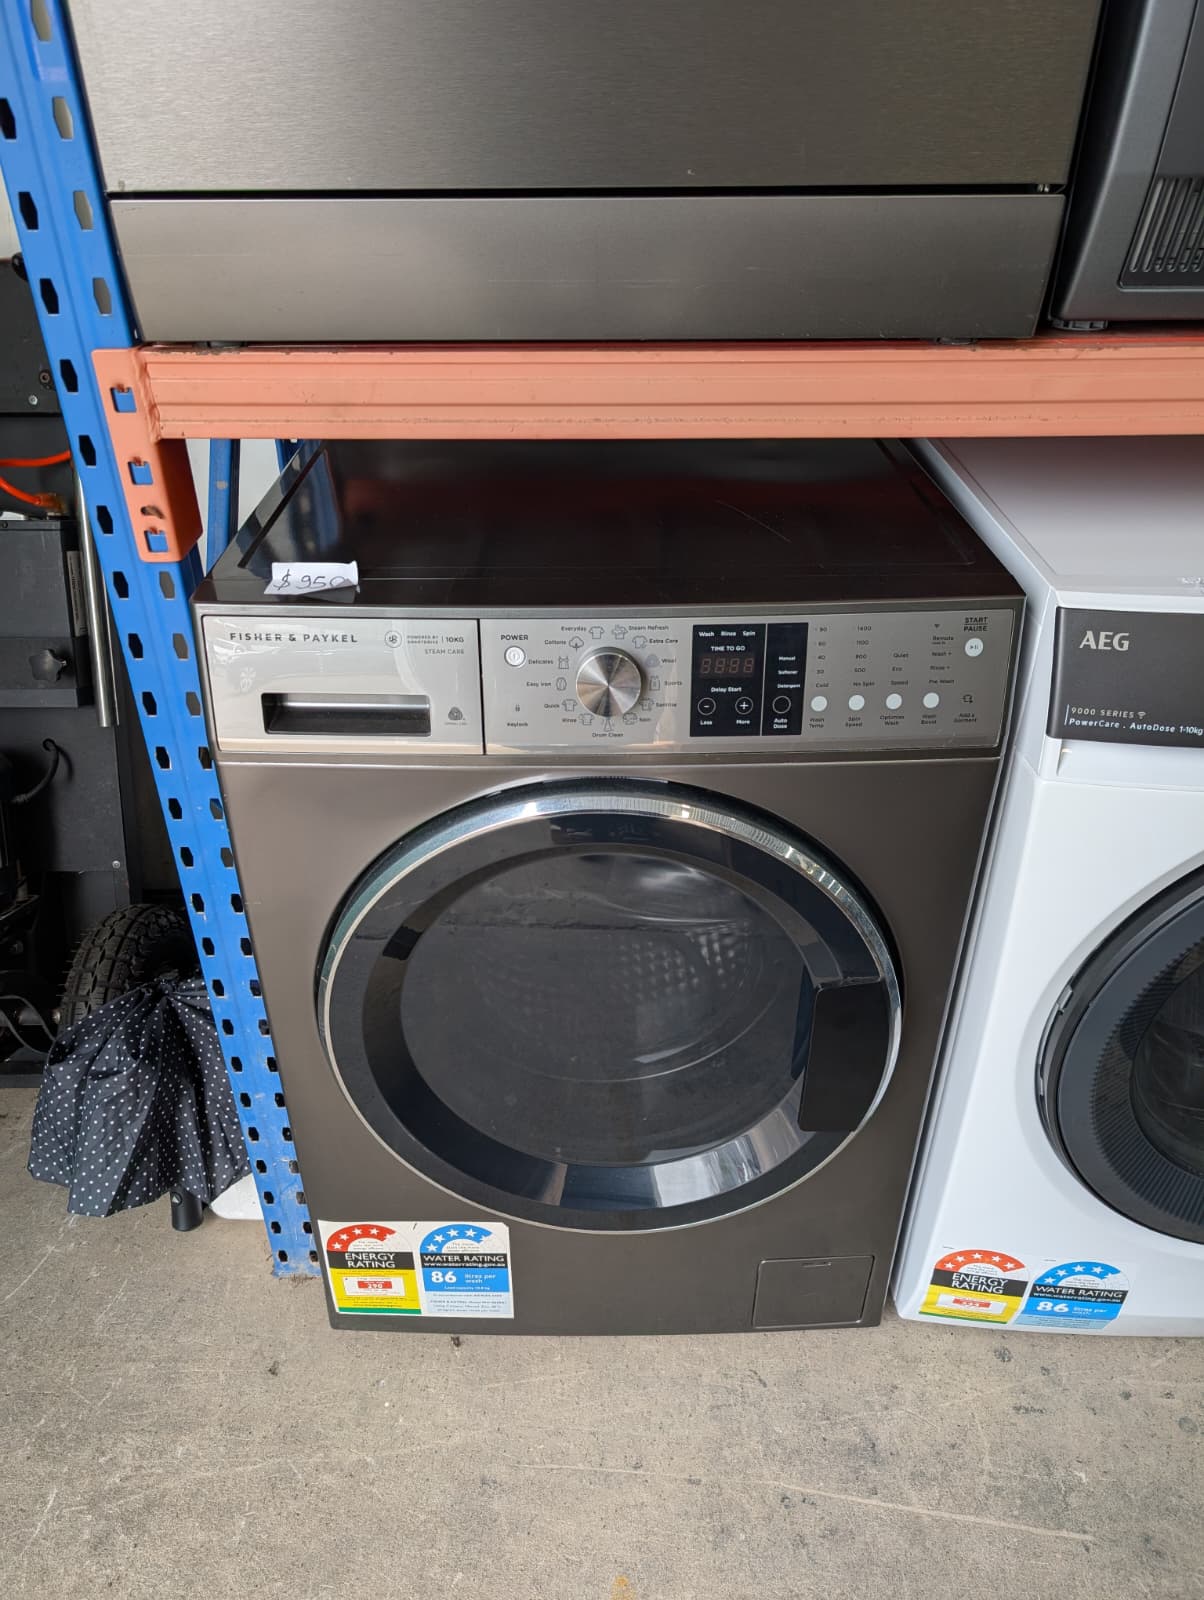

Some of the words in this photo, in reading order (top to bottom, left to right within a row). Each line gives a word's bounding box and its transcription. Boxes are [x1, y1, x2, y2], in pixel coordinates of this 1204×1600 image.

[273, 569, 291, 590] $
[296, 575, 345, 589] 950
[560, 625, 587, 633] Everyday
[230, 632, 283, 642] FISHER
[288, 633, 297, 642] &
[303, 633, 358, 643] PAYKEL
[1079, 630, 1130, 651] AEG
[1071, 707, 1096, 716] 9000
[1100, 709, 1135, 718] SERIES
[1069, 718, 1120, 729] PowerCare
[1129, 722, 1176, 733] AutoDose
[345, 1252, 396, 1261] ENERGY
[347, 1260, 396, 1269] RATING
[431, 1271, 457, 1283] 86
[952, 1273, 1008, 1287] ENERGY
[952, 1280, 1005, 1294] RATING
[1035, 1285, 1075, 1295] WATER
[1079, 1289, 1123, 1298] RATING
[1036, 1301, 1069, 1313] 86
